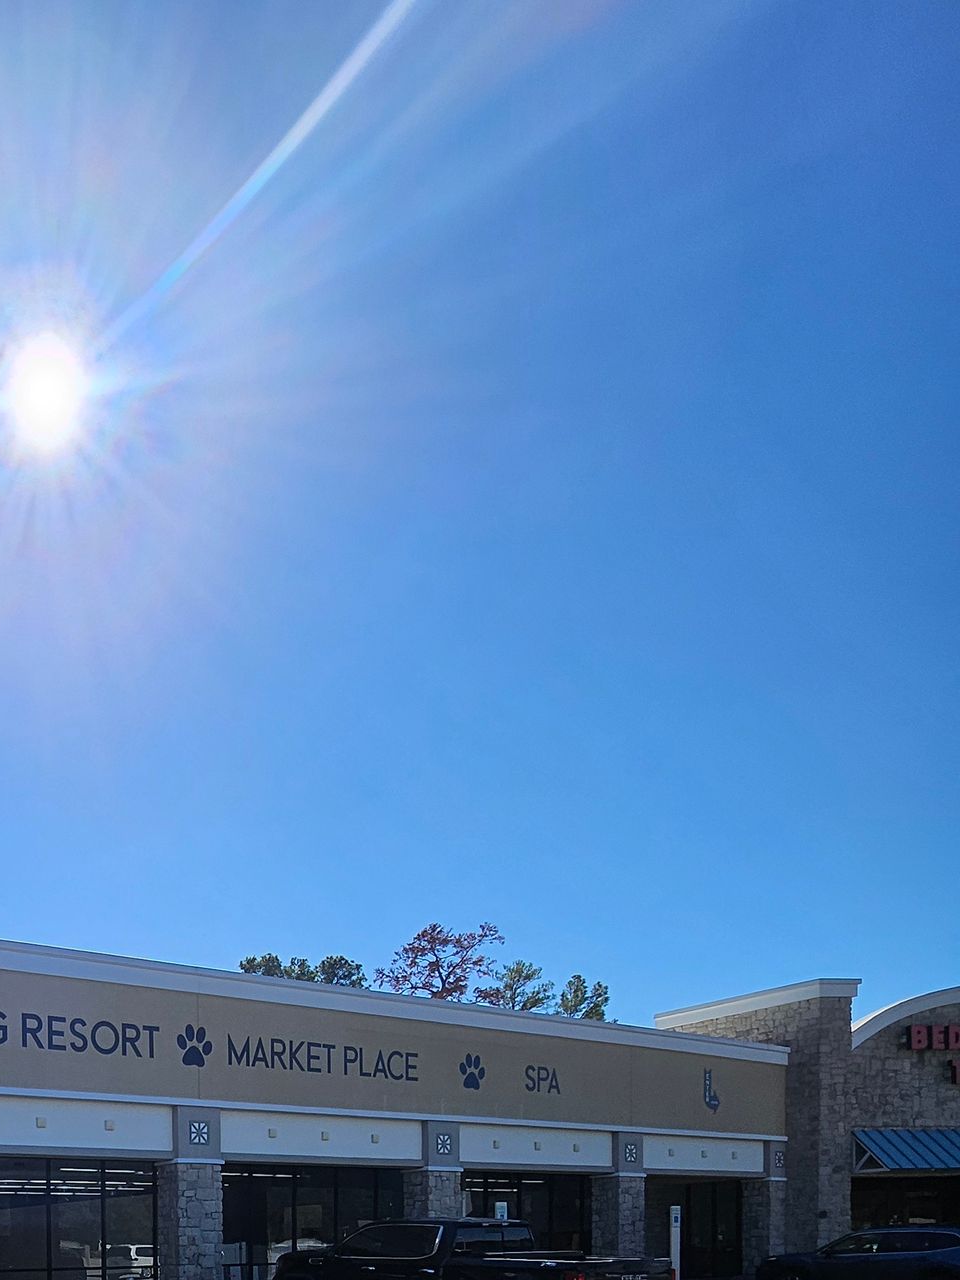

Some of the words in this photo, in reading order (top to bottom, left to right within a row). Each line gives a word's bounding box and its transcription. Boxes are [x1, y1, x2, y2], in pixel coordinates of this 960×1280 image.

[21, 1012, 160, 1059] RESORT
[227, 1033, 337, 1073] MARKET
[343, 1046, 419, 1082] PLACE
[524, 1064, 562, 1095] SPA
